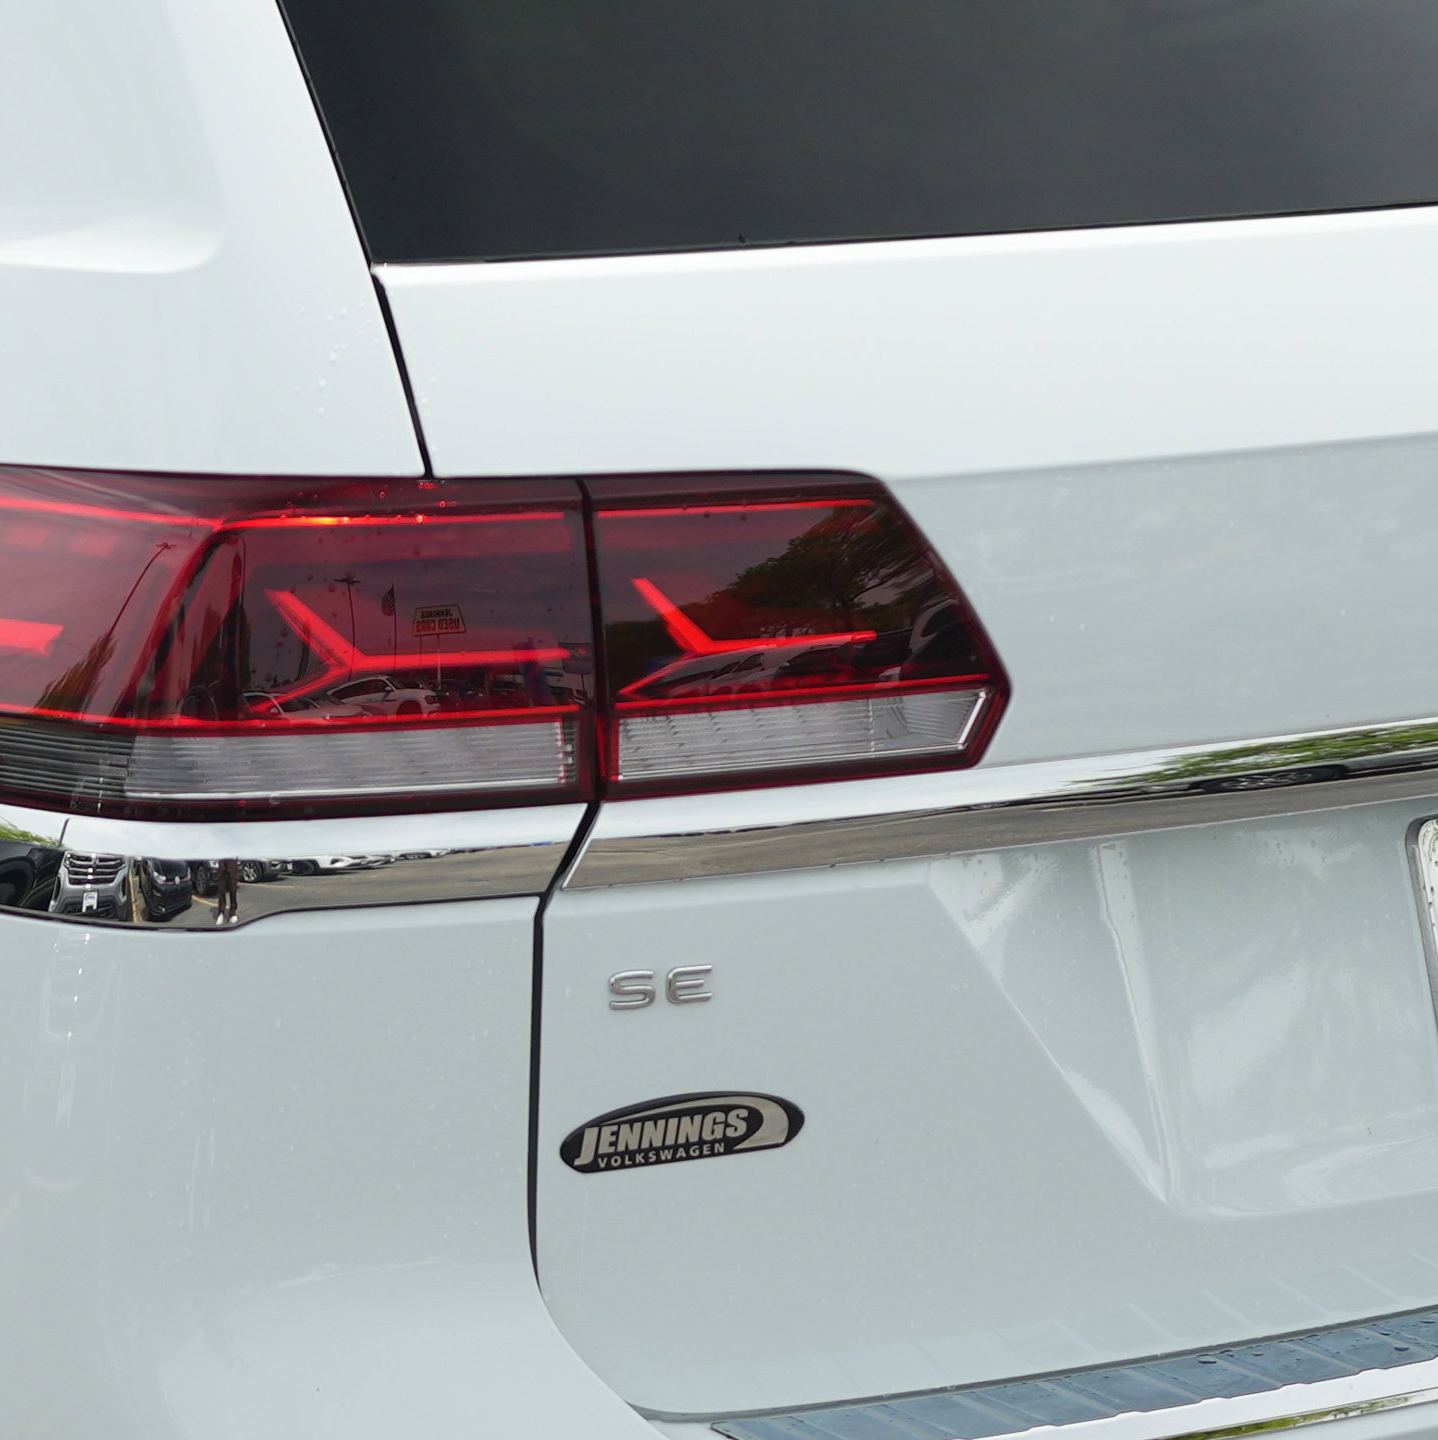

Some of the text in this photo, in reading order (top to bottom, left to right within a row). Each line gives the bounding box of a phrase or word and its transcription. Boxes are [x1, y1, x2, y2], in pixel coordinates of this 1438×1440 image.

[608, 964, 713, 1010] SE
[573, 1108, 749, 1166] JENNINGS
[597, 1142, 725, 1169] VOLKSWAGEN
